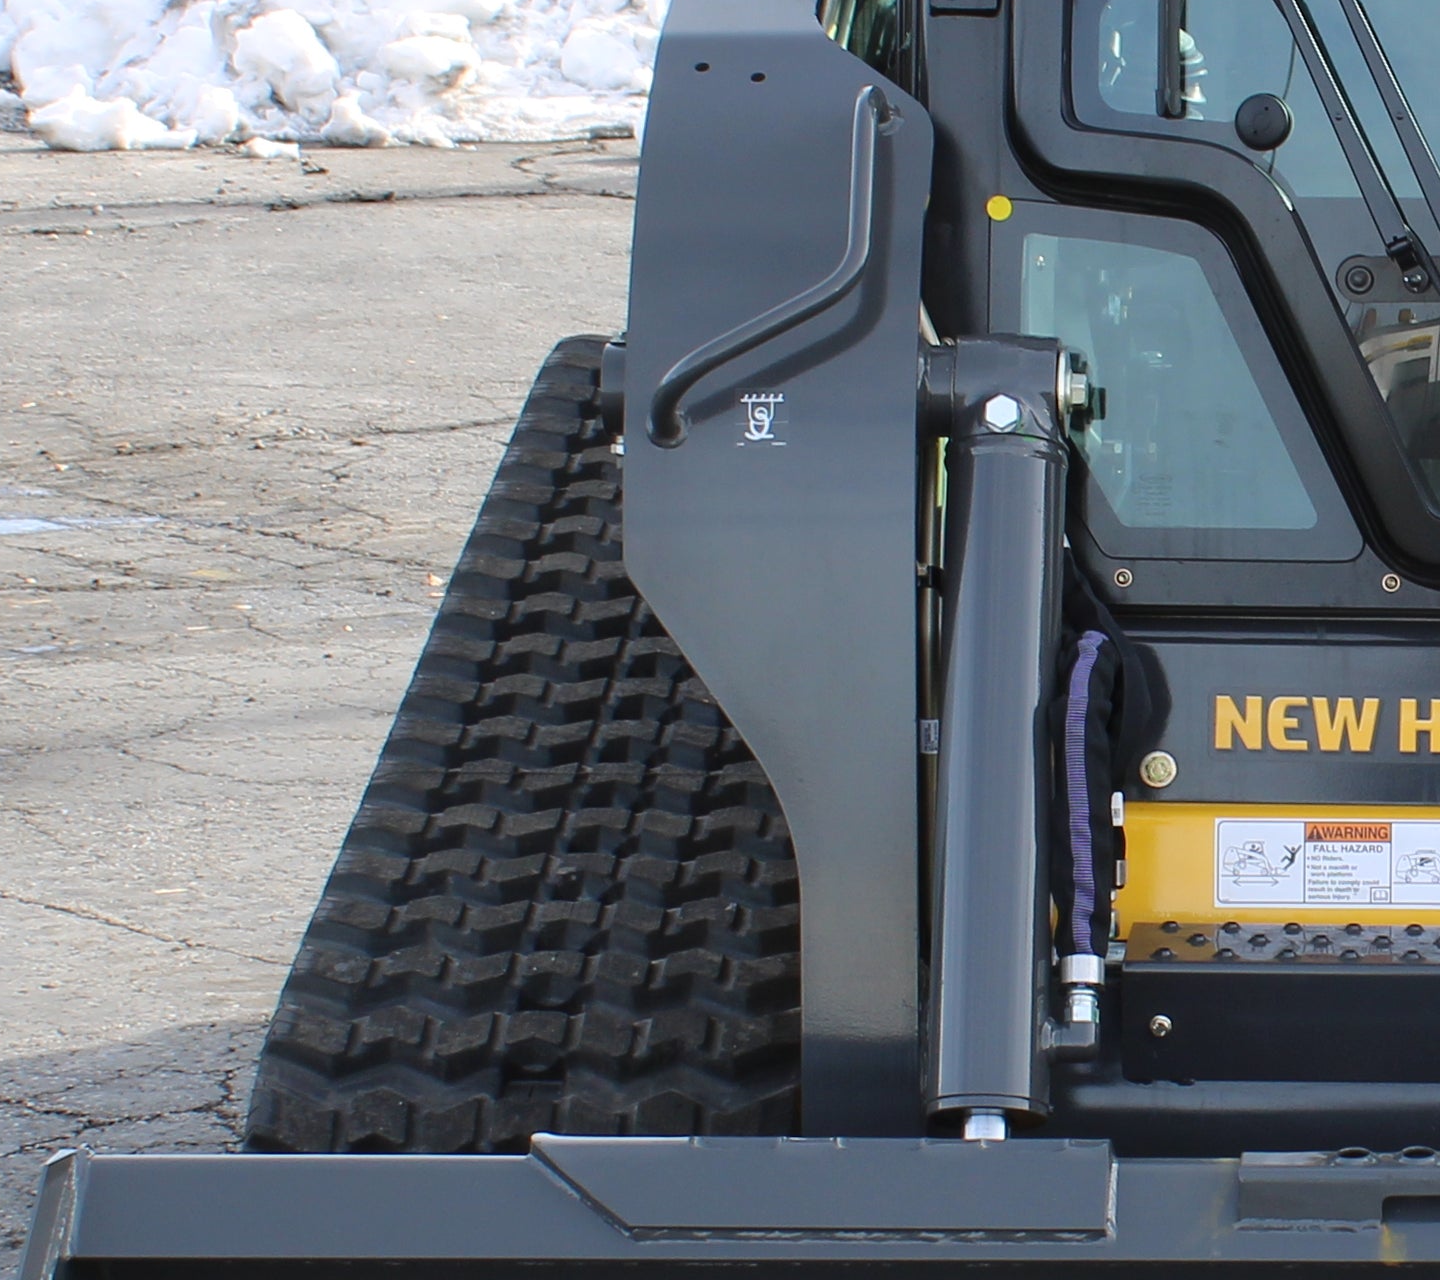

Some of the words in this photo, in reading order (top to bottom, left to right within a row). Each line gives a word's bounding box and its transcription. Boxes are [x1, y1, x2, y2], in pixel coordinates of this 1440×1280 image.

[1214, 694, 1381, 752] NEW
[1322, 826, 1389, 840] WARNING
[1313, 844, 1338, 853] FALL
[1340, 845, 1384, 854] HAZARD
